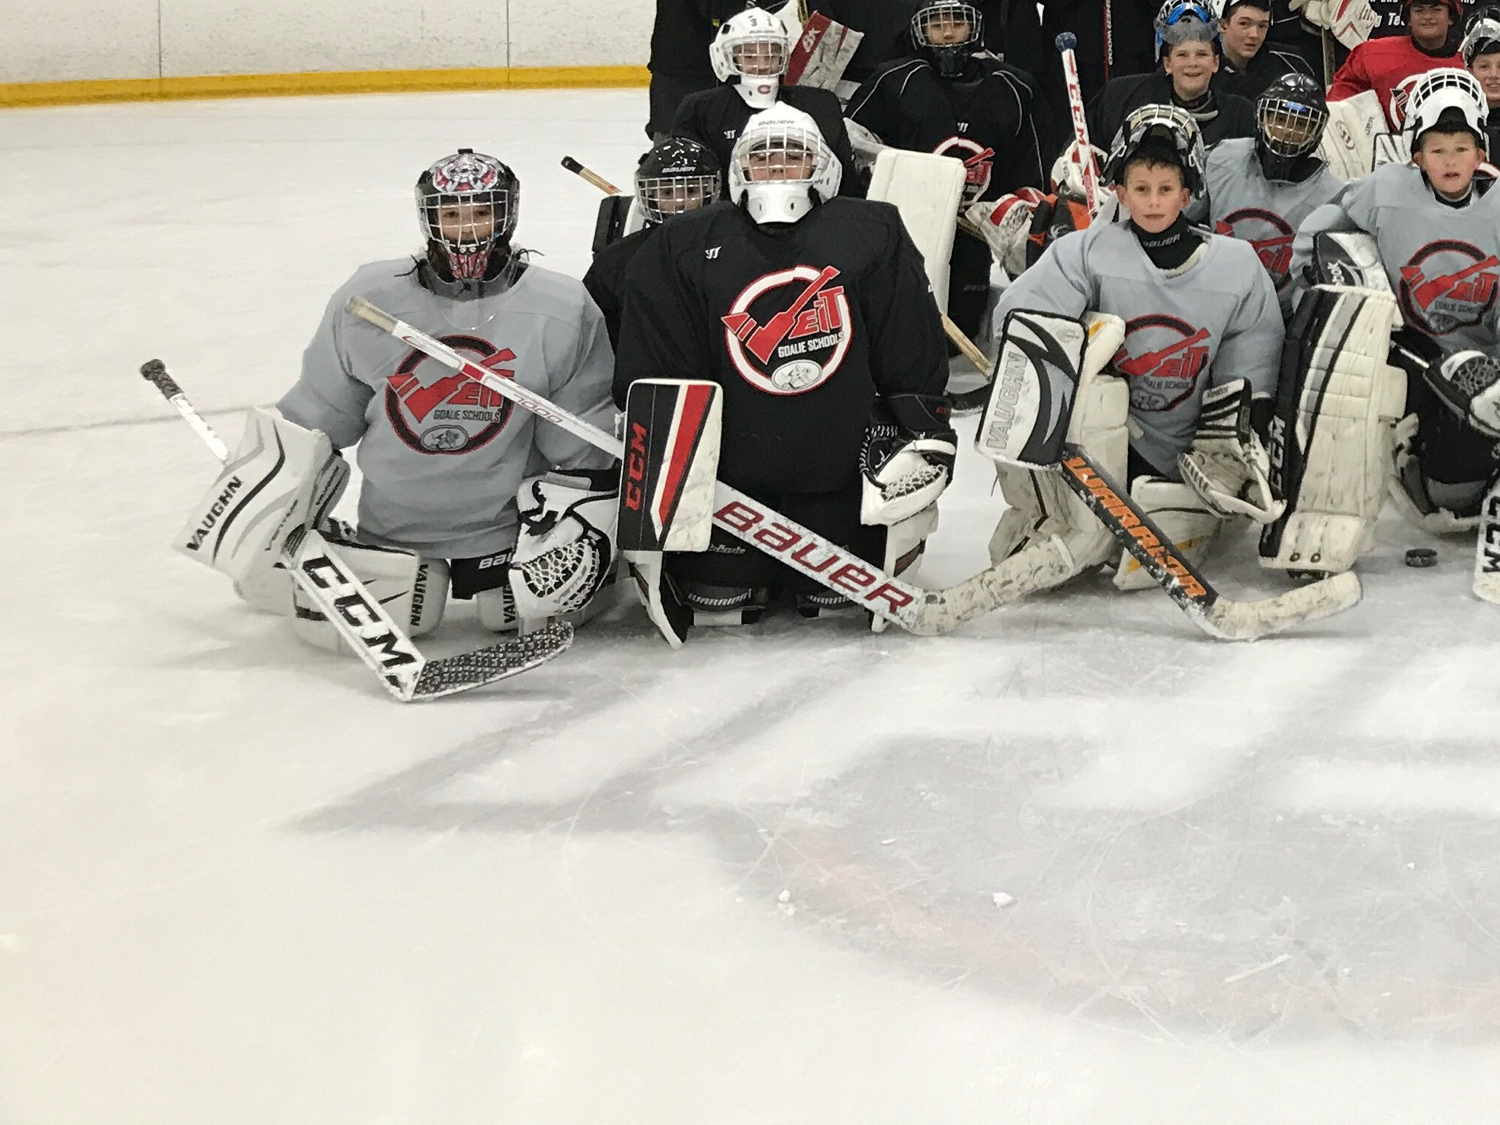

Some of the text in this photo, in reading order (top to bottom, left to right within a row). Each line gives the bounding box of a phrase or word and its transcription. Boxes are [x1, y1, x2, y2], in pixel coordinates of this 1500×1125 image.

[778, 331, 846, 358] GOALIE SCHOOLS
[433, 409, 502, 423] GOALIE SCHOOLS
[985, 351, 1029, 452] VAUGHN
[625, 423, 648, 511] CCM
[1269, 413, 1288, 493] CCM
[185, 475, 243, 553] VAUGHN
[1063, 455, 1208, 598] WARRIOR
[302, 554, 418, 669] CCM
[410, 562, 430, 627] VAUGHN
